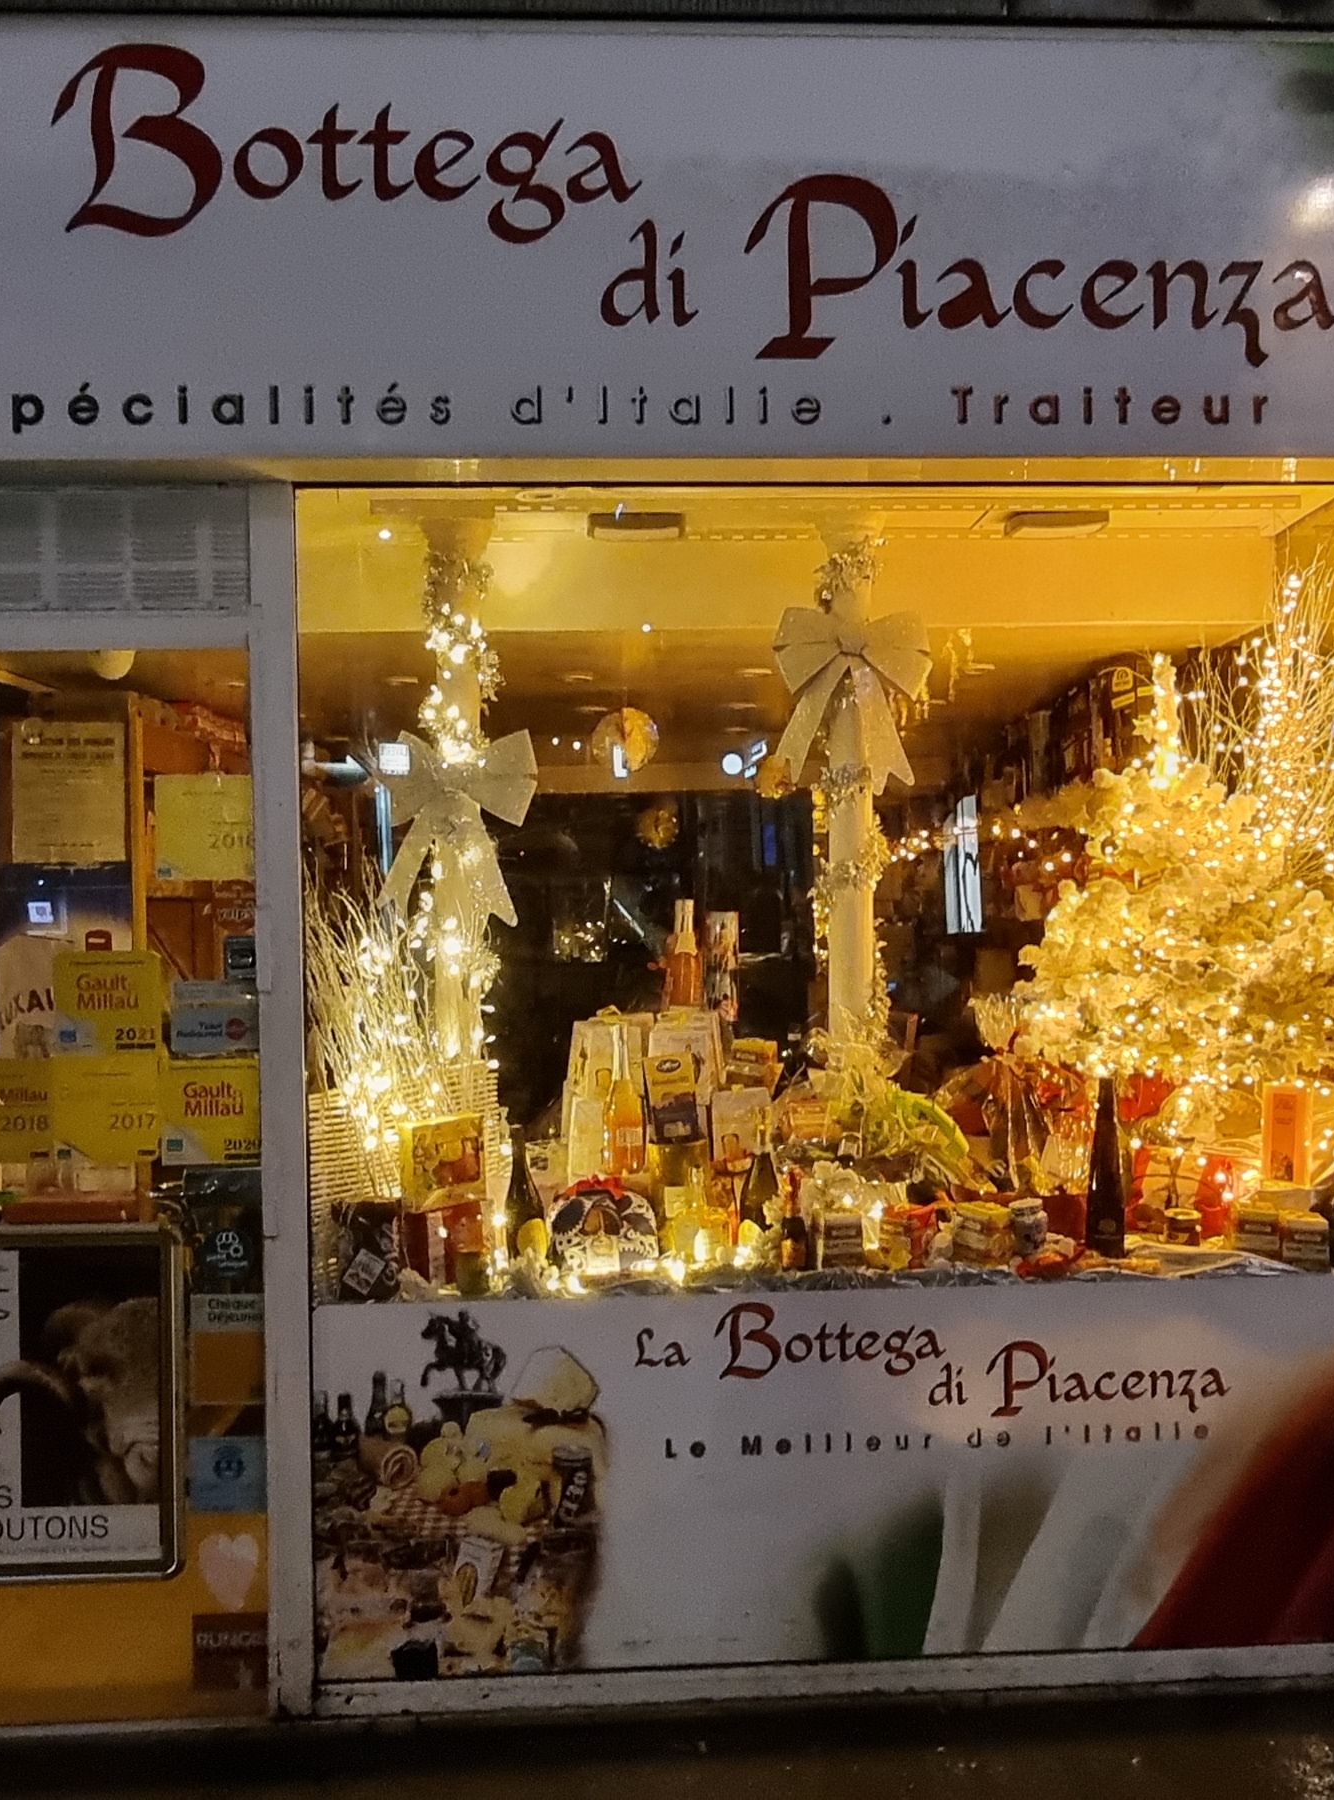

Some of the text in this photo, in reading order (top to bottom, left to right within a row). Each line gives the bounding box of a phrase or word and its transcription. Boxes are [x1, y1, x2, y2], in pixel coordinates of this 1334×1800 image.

[50, 42, 643, 245] Bottega
[600, 219, 699, 328] di
[510, 384, 822, 426] d'Italie
[950, 386, 1269, 427] Traiteur
[76, 991, 140, 1011] Millau
[114, 1027, 155, 1041] 2021
[1, 1114, 49, 1132] 2018
[108, 1112, 157, 1131] 2017
[183, 1099, 245, 1117] Millau
[634, 1301, 947, 1381] La Bottega
[927, 1339, 1233, 1417] di Piacenza
[664, 1420, 1210, 1459] Le Meilleur de l'Italie
